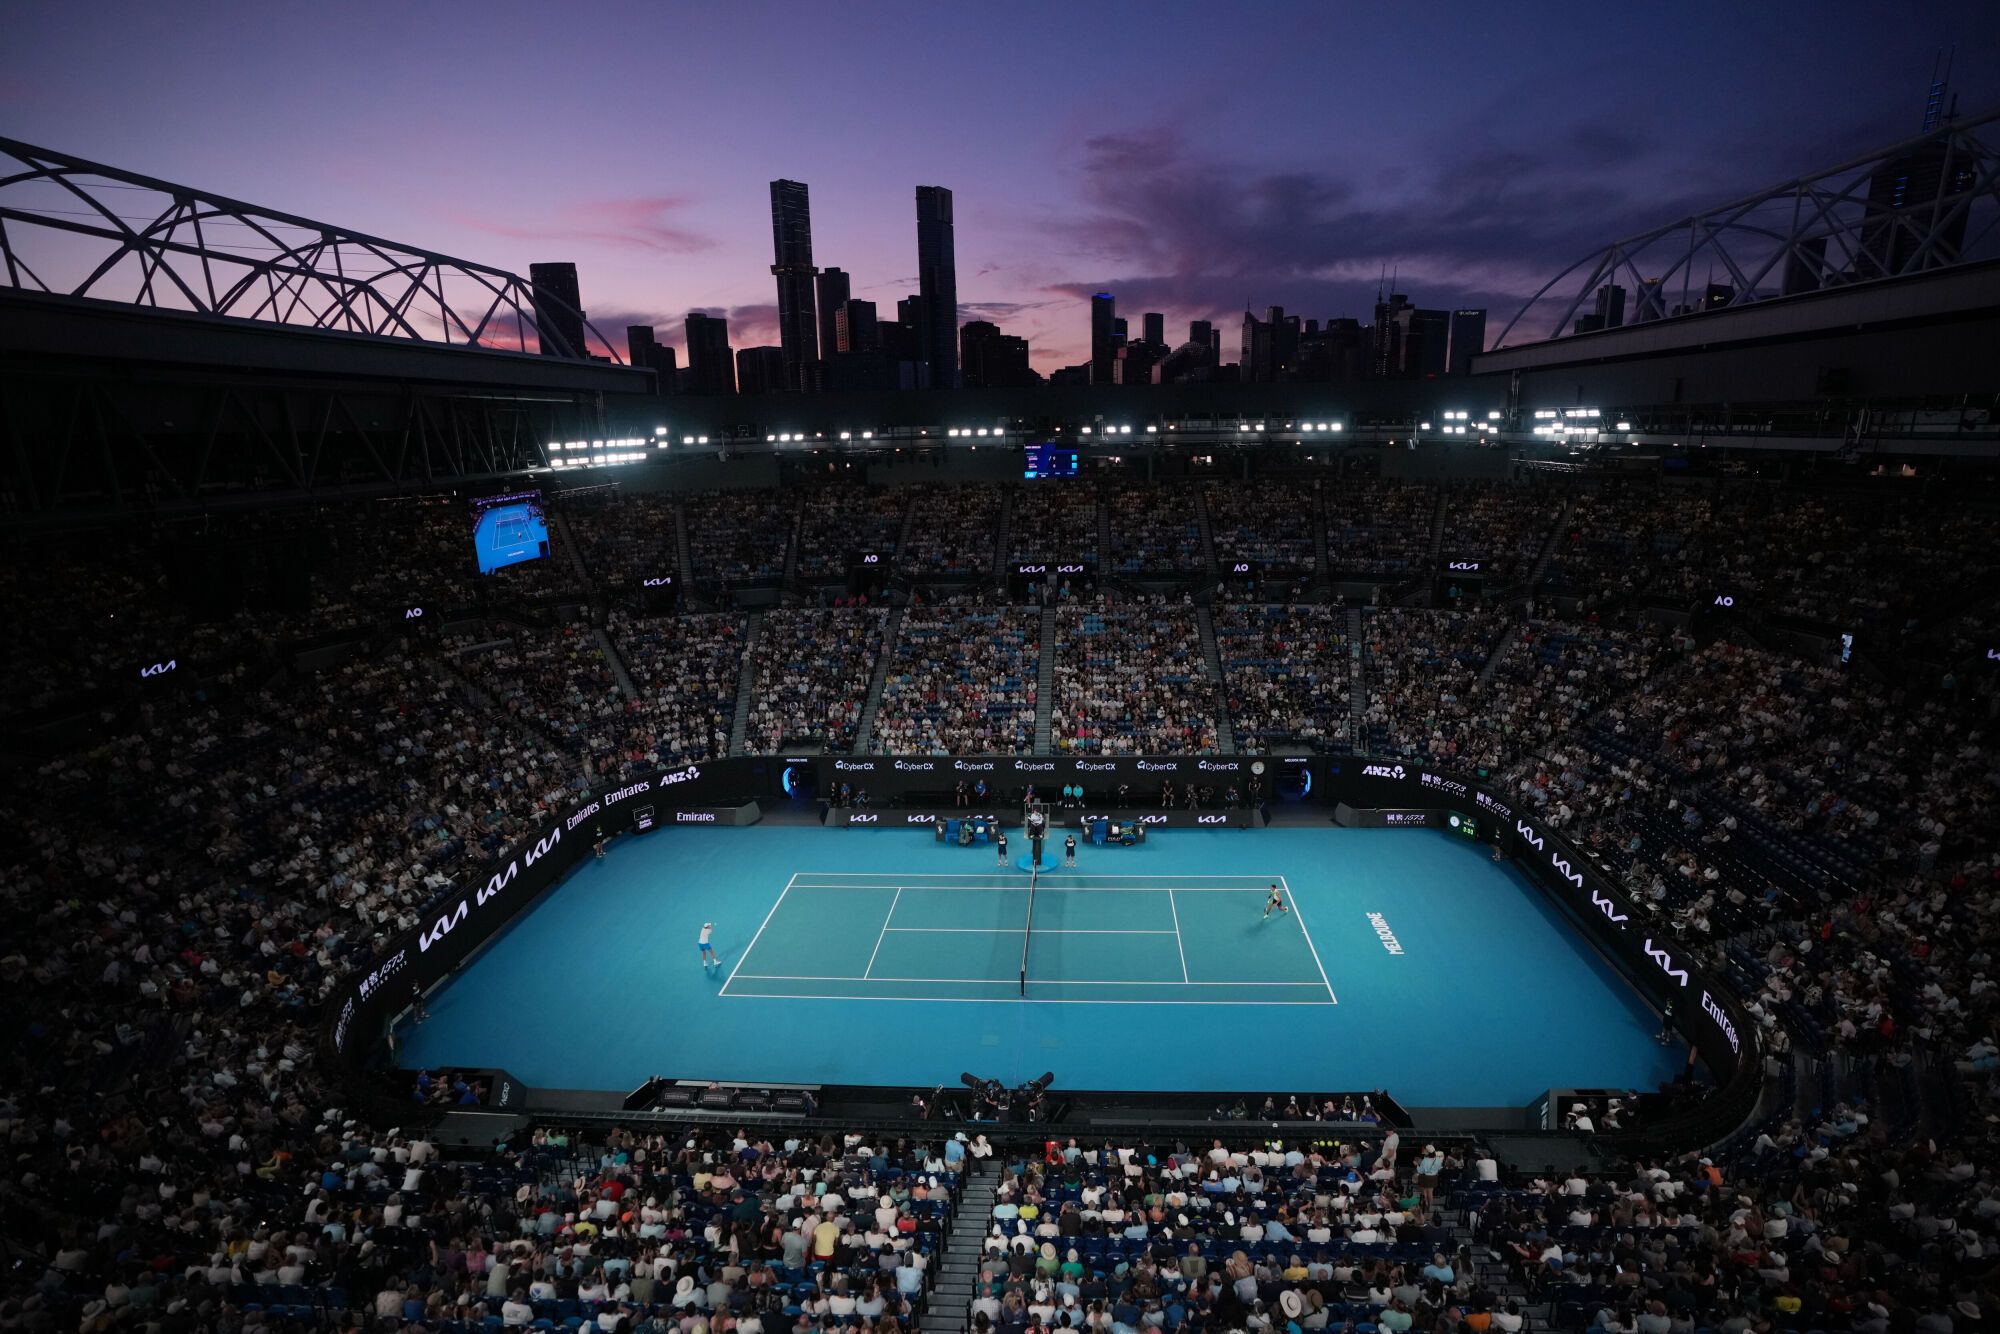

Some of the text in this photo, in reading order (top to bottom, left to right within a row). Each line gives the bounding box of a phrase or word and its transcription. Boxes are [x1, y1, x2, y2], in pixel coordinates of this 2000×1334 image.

[863, 554, 879, 563] AO
[1233, 563, 1249, 572] AO
[1714, 595, 1734, 607] AO
[405, 607, 423, 619] AO
[843, 762, 875, 772] CyberCX
[903, 762, 934, 772] CyberCX
[963, 762, 994, 772] CyberCX
[1023, 762, 1055, 772] CyberCX
[1084, 762, 1116, 772] CyberCX
[1145, 762, 1178, 772] CyberCX
[1207, 762, 1239, 772] CyberCX
[1361, 765, 1391, 778] ANZ
[660, 771, 687, 788] ANZ
[604, 780, 651, 806] Emirates
[566, 801, 600, 832] Emirates
[676, 811, 716, 823] Emirates
[525, 827, 561, 868] KIA
[476, 860, 518, 907] KIA
[418, 900, 468, 953] KIA
[1701, 990, 1740, 1054] Emirates
